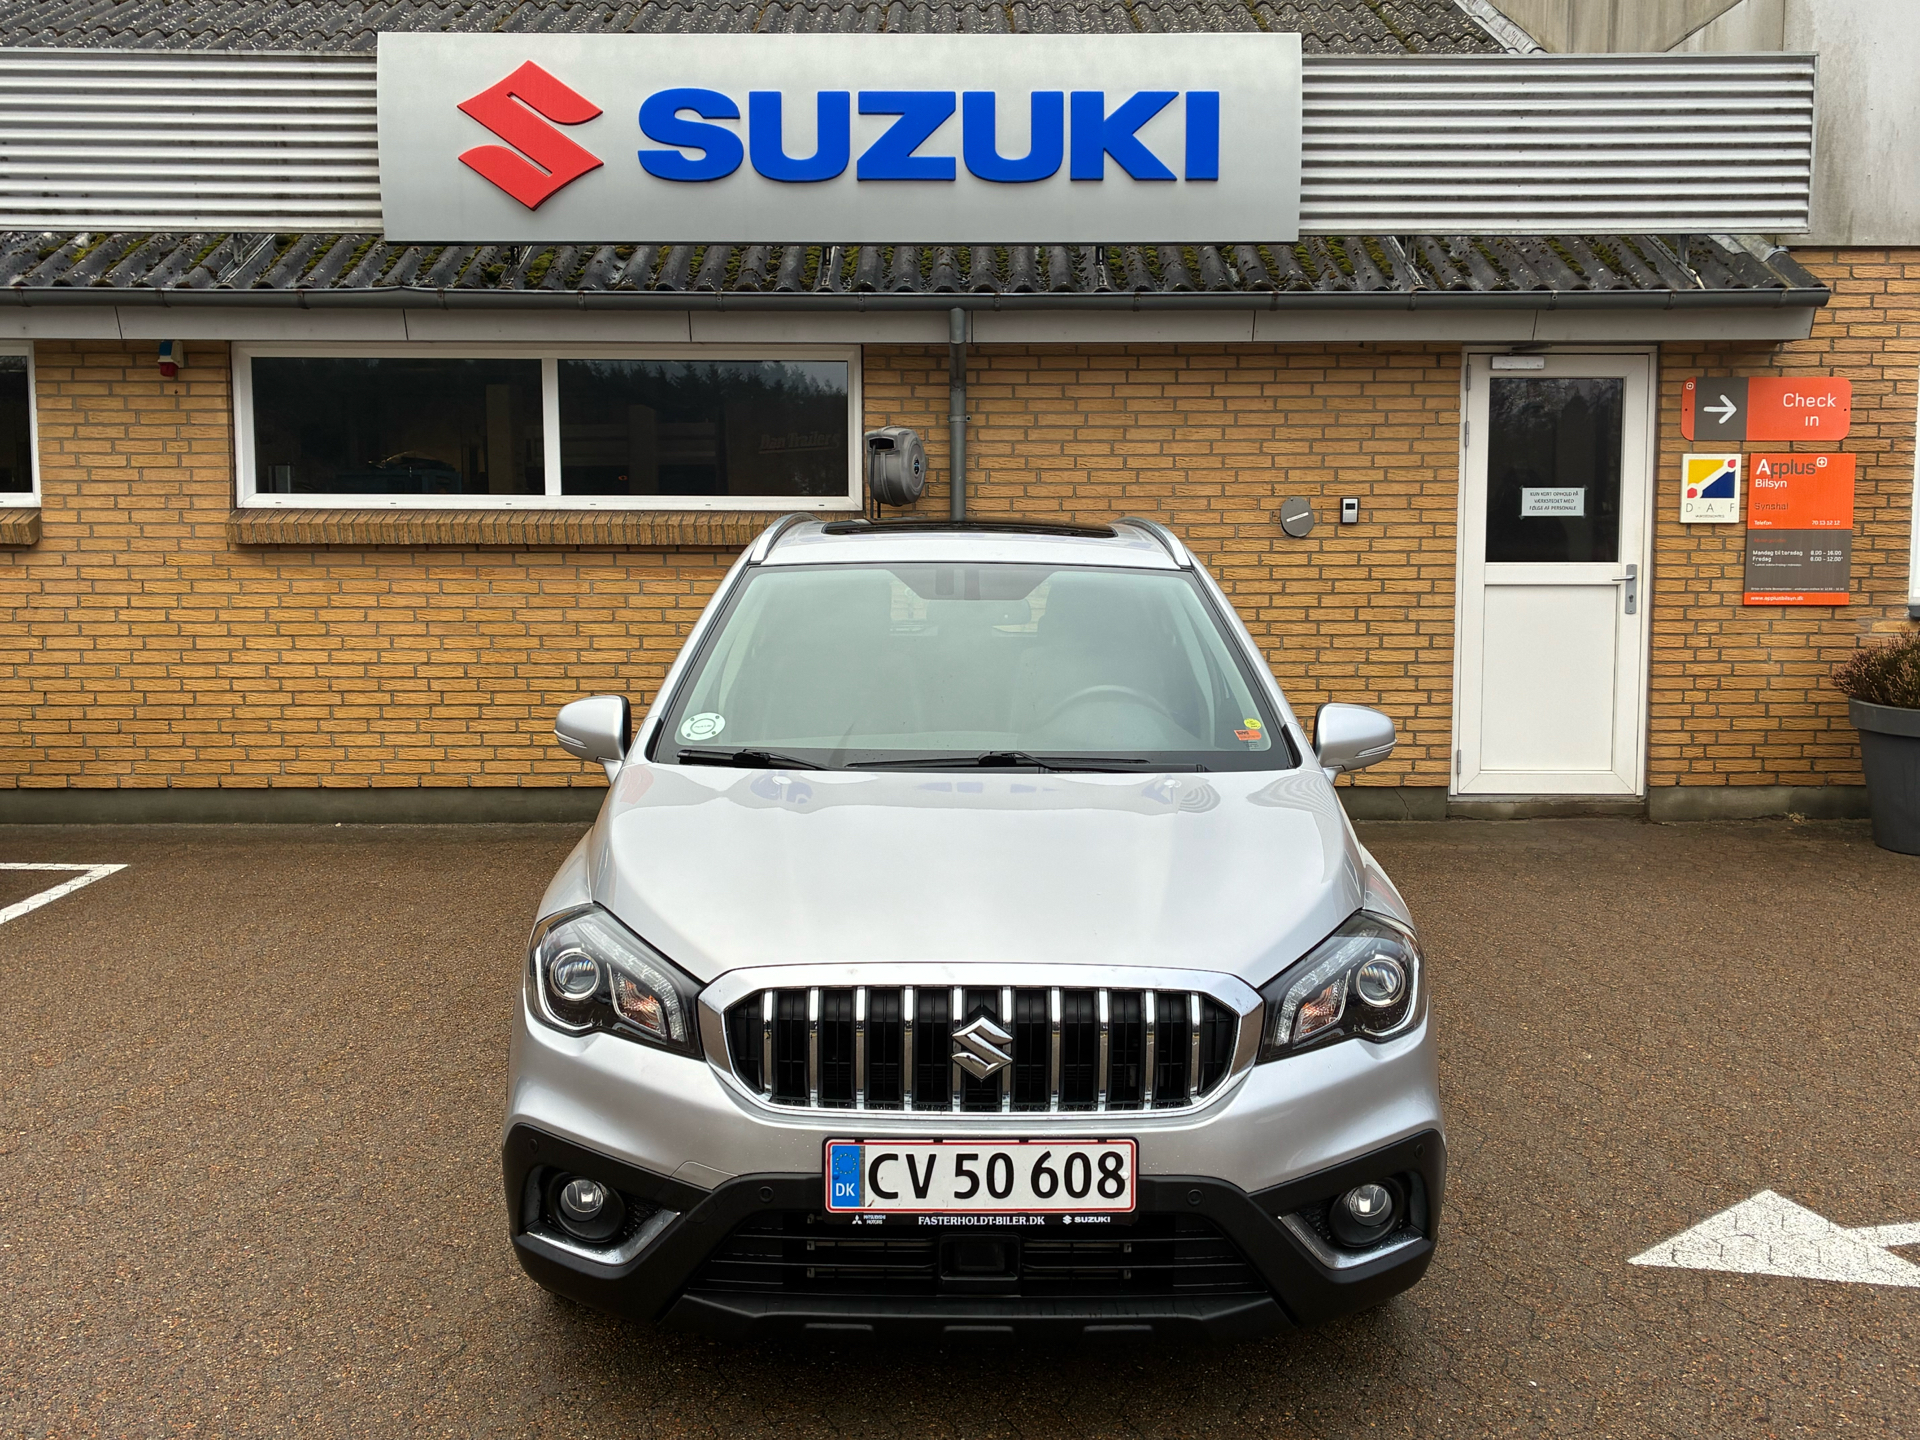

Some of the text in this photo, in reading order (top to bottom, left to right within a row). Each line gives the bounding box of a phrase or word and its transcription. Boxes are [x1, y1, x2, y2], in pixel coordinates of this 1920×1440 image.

[637, 87, 1220, 183] SUZUKI
[1782, 393, 1836, 408] Check
[1805, 414, 1820, 427] in
[1755, 458, 1816, 479] Applus
[1755, 478, 1788, 490] Bilsyn
[868, 1150, 1126, 1199] CV 50 608
[835, 1182, 855, 1197] DK
[918, 1216, 1046, 1226] FASTERHOLDT-BILER.DK
